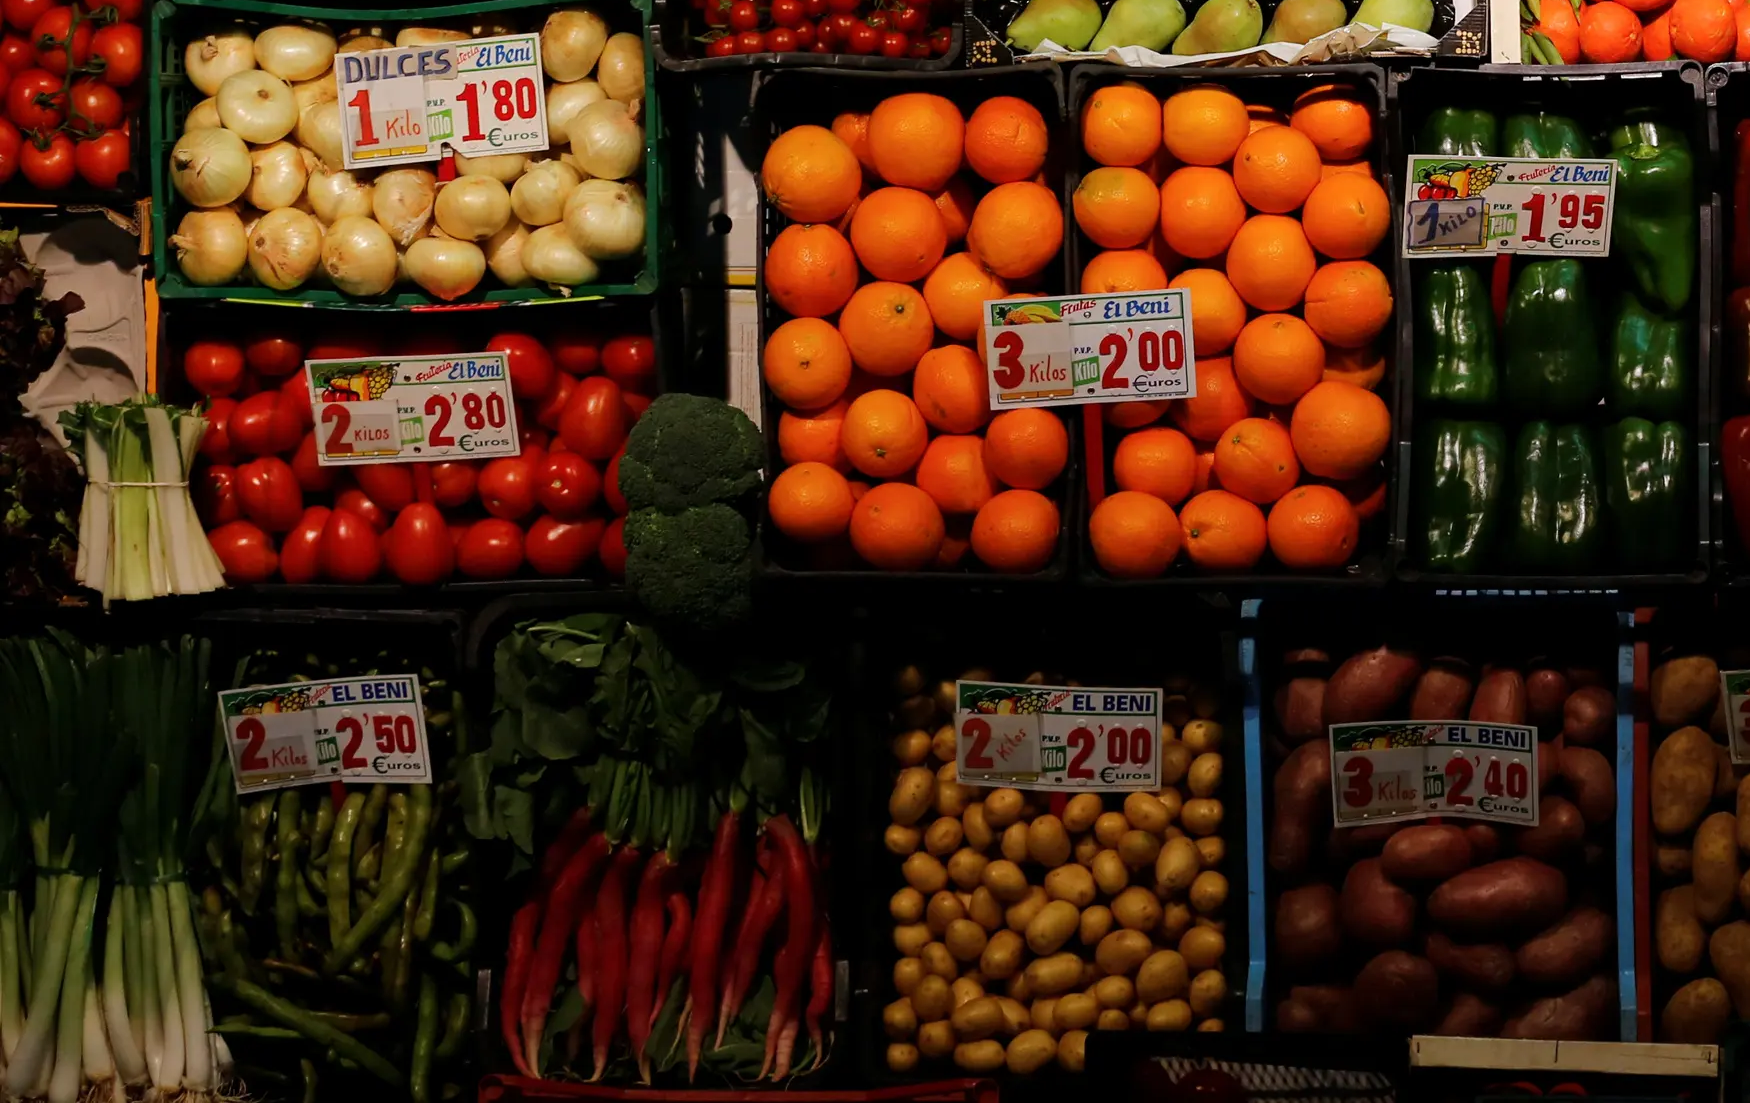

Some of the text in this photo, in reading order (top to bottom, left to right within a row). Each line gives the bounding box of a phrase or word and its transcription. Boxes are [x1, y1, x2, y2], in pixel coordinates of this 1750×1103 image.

[344, 49, 453, 85] DULCES
[349, 89, 381, 147] 1
[456, 77, 538, 142] 1'80
[1551, 166, 1571, 183] El
[1572, 165, 1609, 183] Beni
[1417, 203, 1439, 245] 1
[1521, 190, 1605, 243] 1'95
[991, 330, 1067, 390] 3 Kilos
[1099, 327, 1183, 390] 2'00
[322, 404, 354, 455] 2
[424, 391, 507, 449] 2'80
[332, 681, 408, 704] EL BENI
[235, 717, 270, 772] 2
[335, 714, 417, 770] 2'50
[962, 717, 995, 770] 2
[1067, 723, 1152, 780] 2'00
[1342, 757, 1375, 808] 3
[1444, 754, 1528, 807] 2'40
